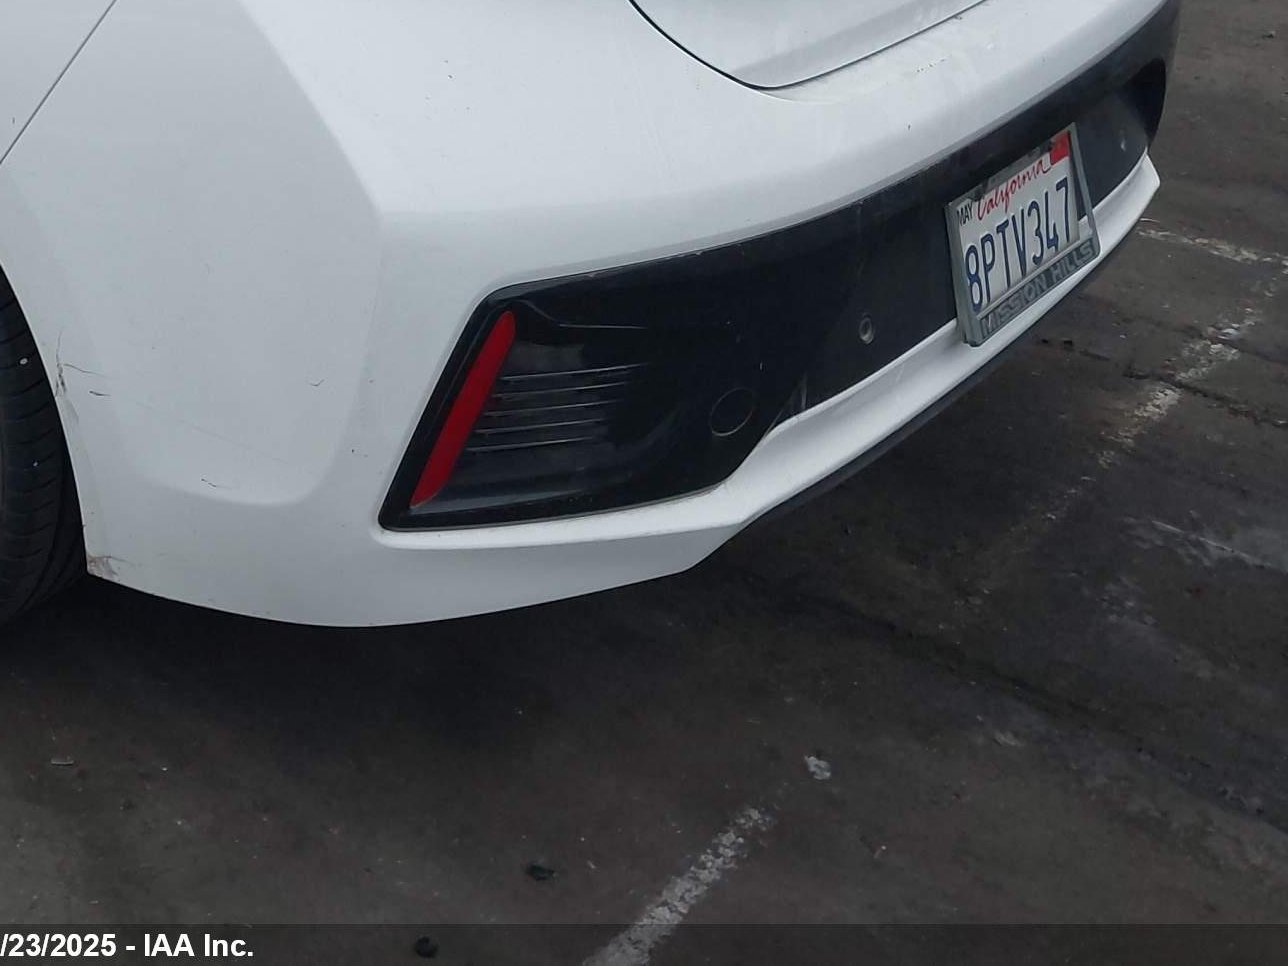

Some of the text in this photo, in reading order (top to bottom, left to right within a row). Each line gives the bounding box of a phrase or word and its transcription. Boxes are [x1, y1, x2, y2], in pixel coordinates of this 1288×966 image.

[956, 159, 1051, 227] MAY California
[964, 177, 1071, 316] 8PTV347
[980, 239, 1096, 339] MISSION HILLS
